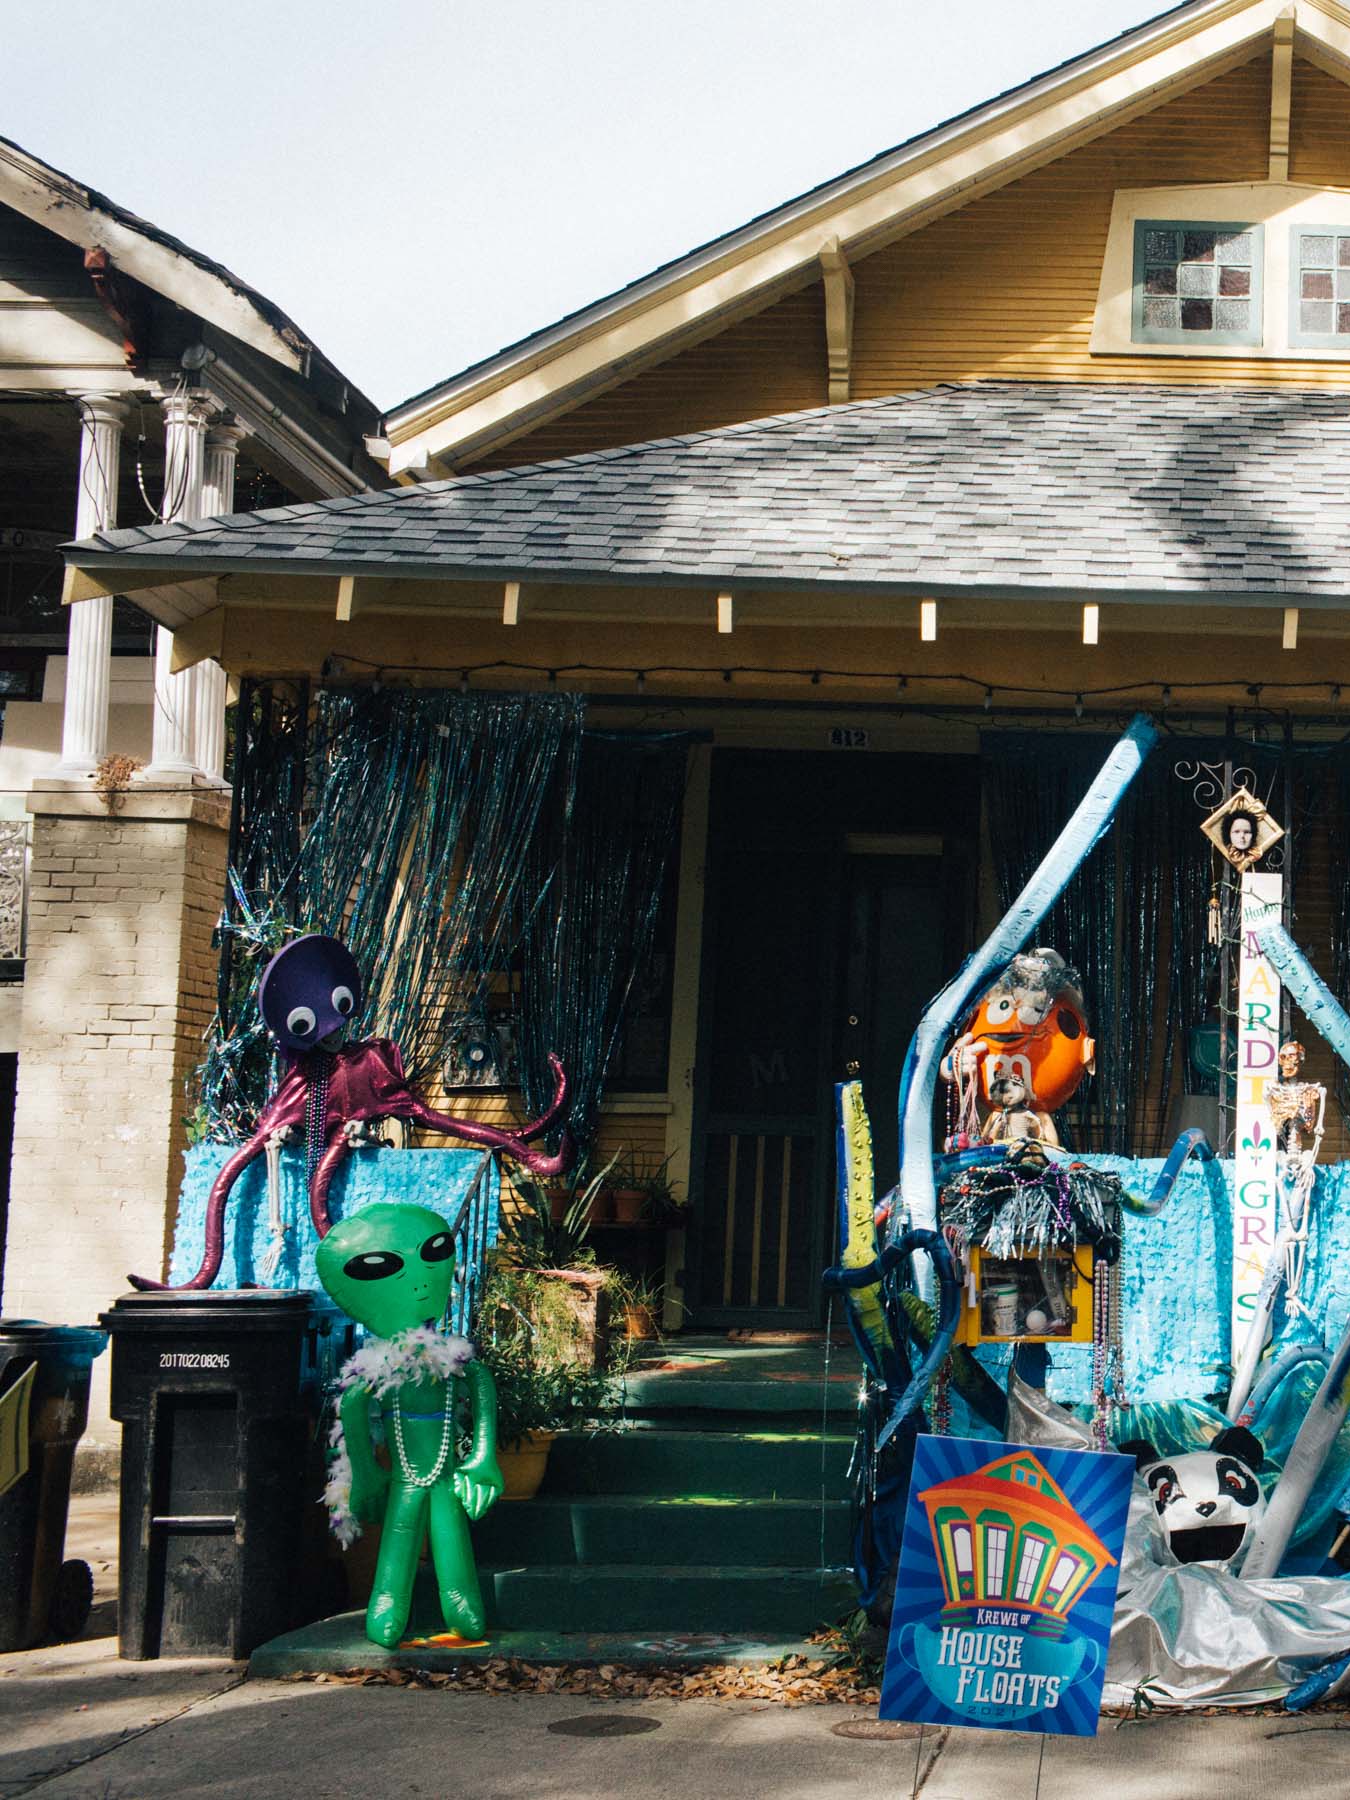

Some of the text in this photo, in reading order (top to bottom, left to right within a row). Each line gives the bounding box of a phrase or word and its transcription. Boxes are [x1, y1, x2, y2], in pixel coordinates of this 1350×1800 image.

[832, 727, 866, 746] 812
[976, 1608, 1031, 1626] KREWE OF
[937, 1626, 1025, 1669] HOUSE
[955, 1665, 1062, 1709] FLOATS
[967, 1705, 1017, 1717] 2021
